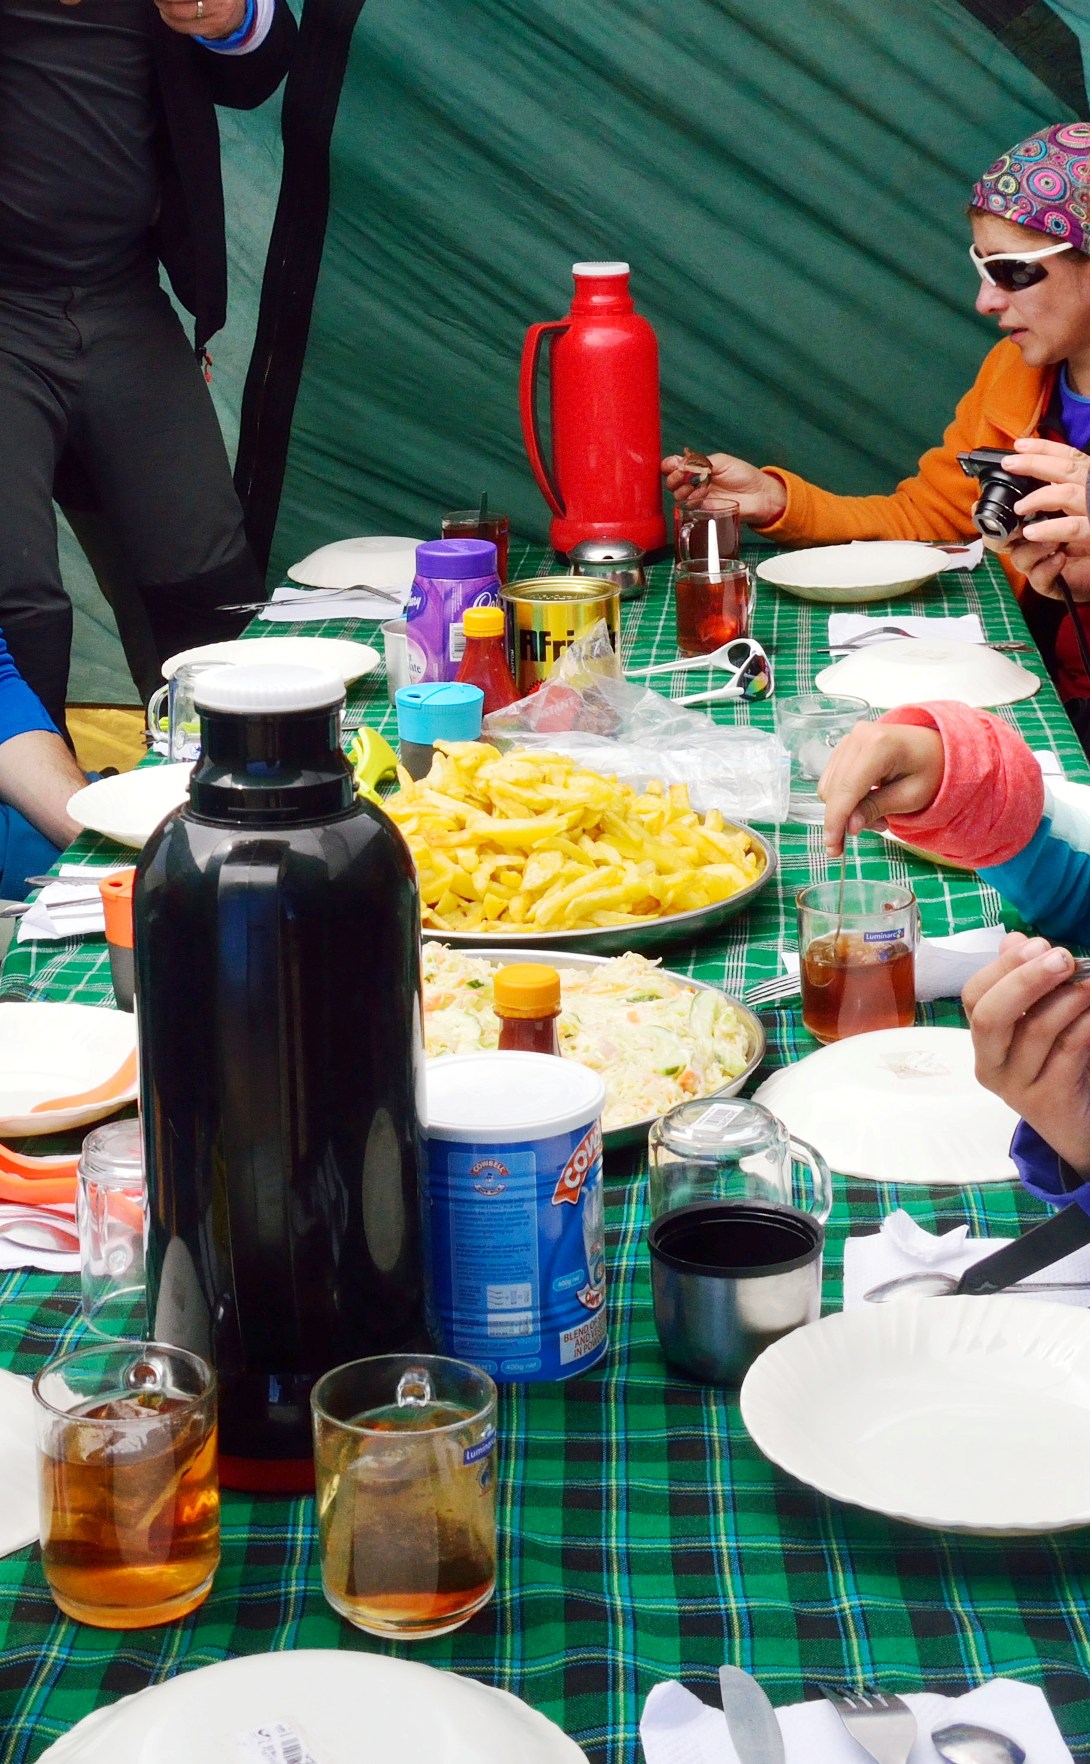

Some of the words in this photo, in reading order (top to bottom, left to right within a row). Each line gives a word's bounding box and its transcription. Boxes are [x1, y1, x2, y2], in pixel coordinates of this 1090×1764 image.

[866, 931, 898, 940] Luminarc
[473, 1160, 505, 1172] COWBELL
[564, 1322, 589, 1343] BLEND
[575, 1332, 591, 1348] AND
[574, 1348, 582, 1358] IN
